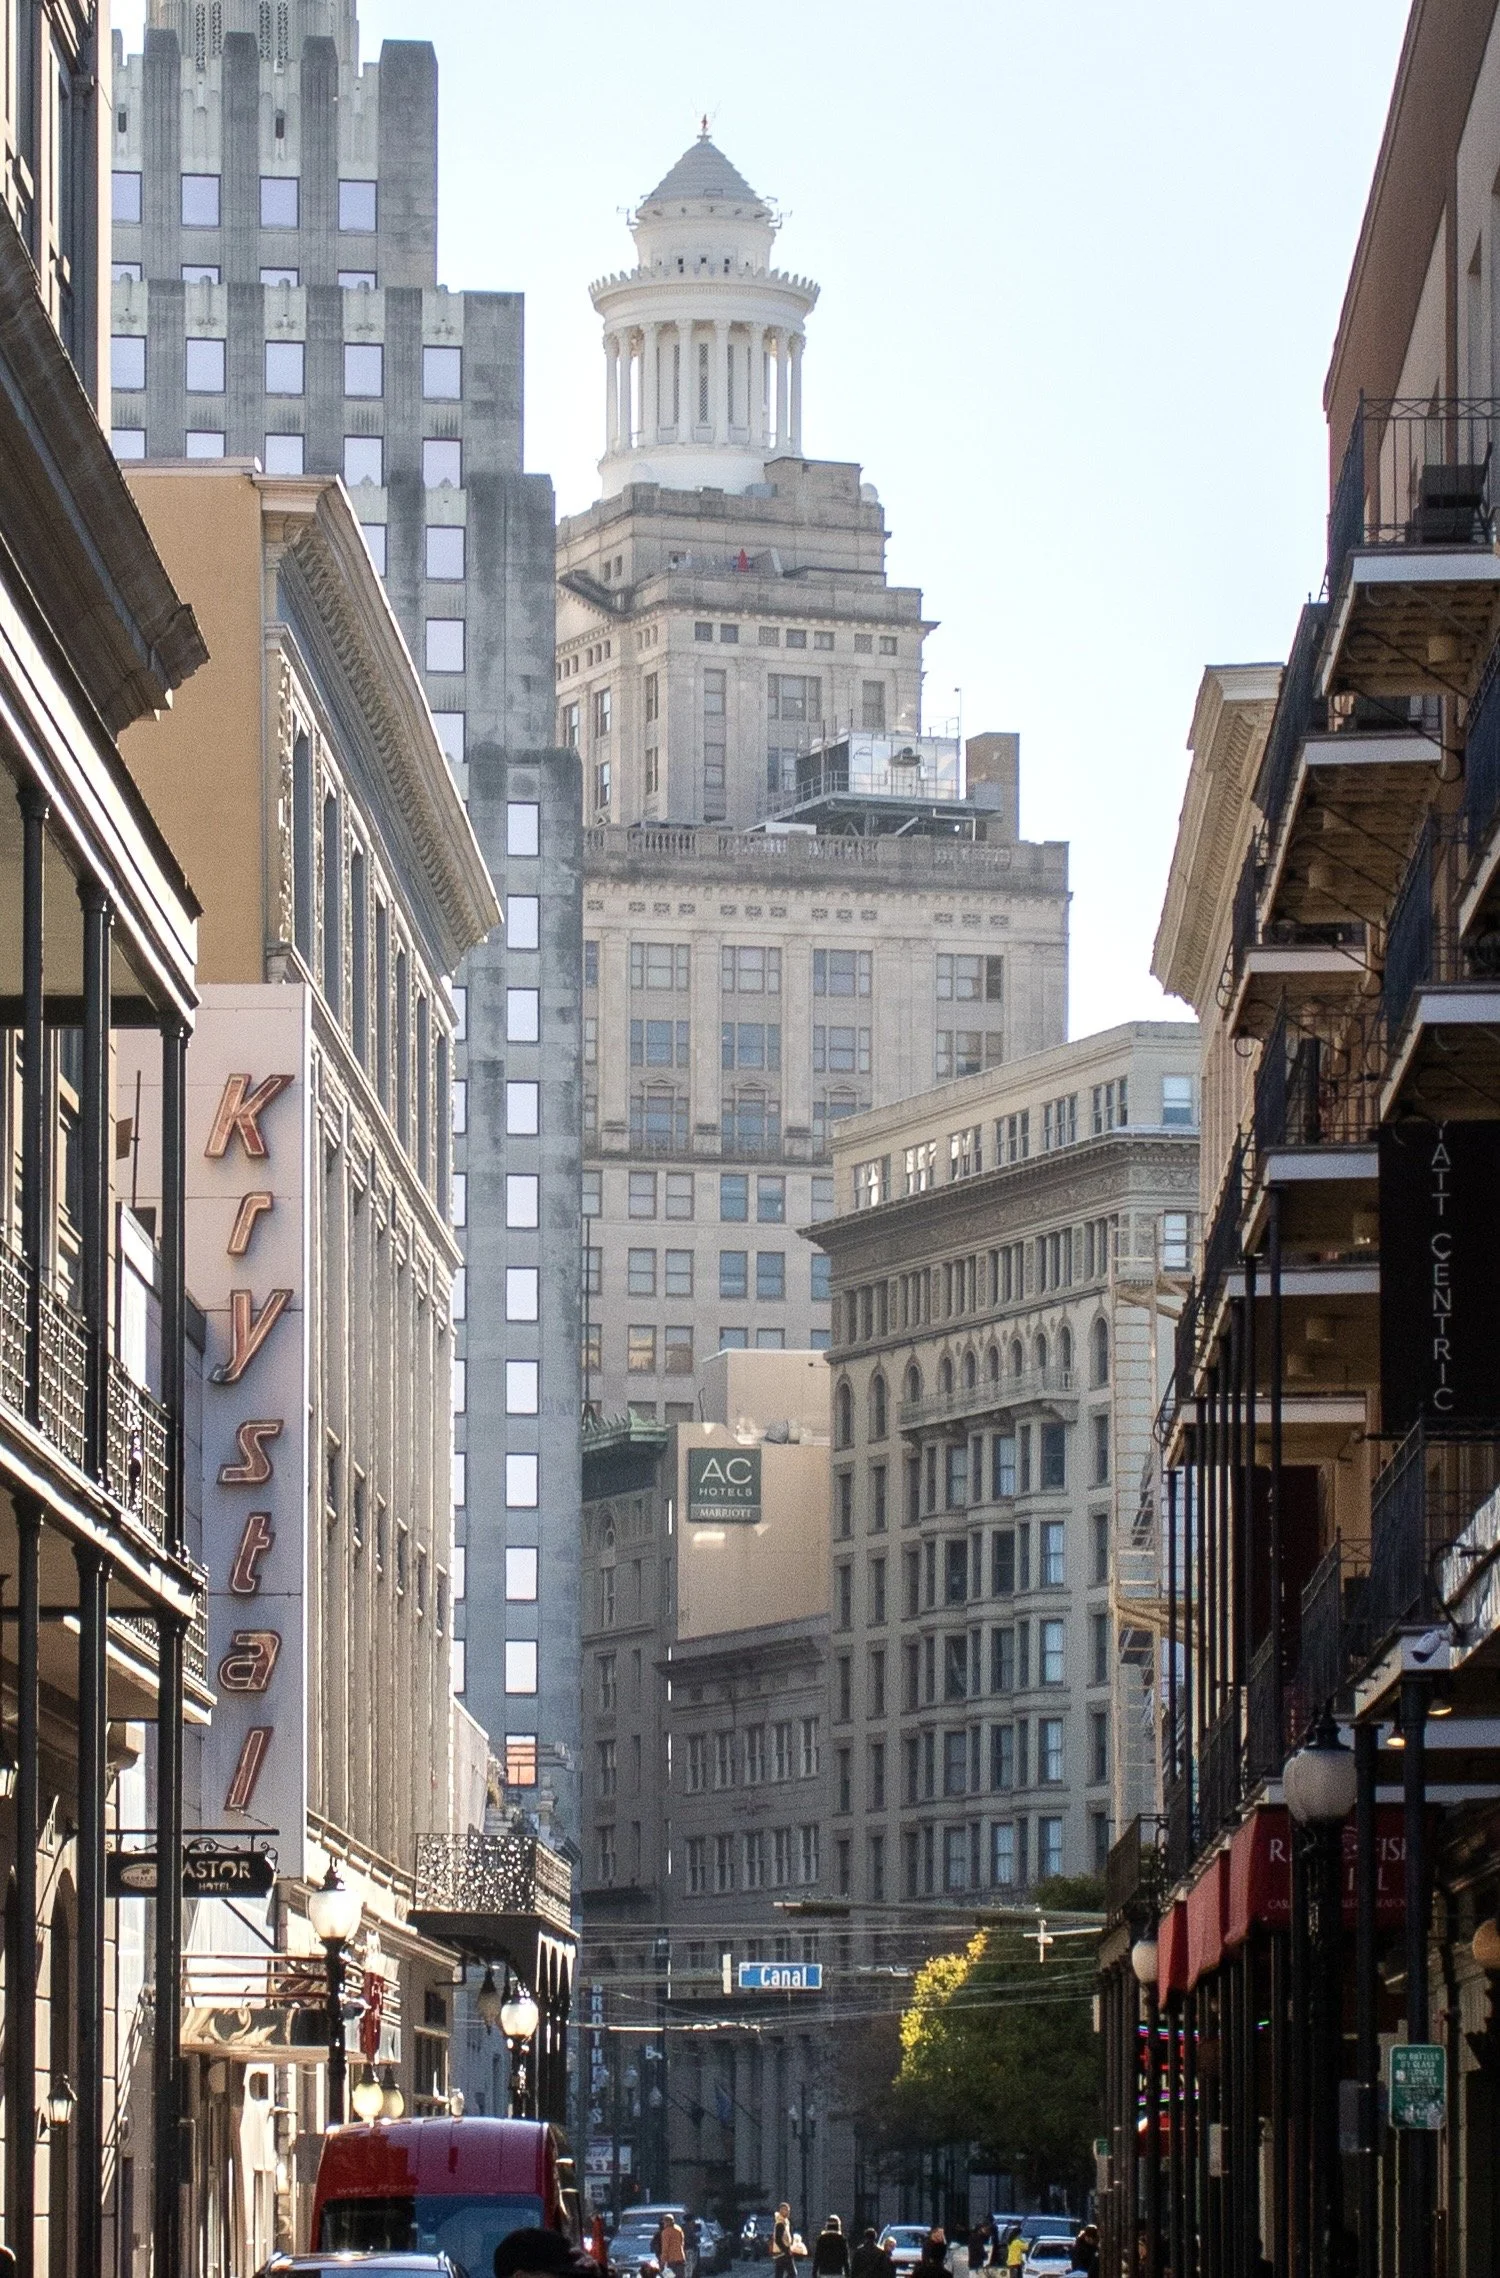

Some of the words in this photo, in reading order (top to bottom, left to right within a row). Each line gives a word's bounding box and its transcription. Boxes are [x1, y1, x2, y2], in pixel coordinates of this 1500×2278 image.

[1431, 1232, 1453, 1411] CENTRIC
[203, 1073, 295, 1811] Krystal
[700, 1457, 752, 1485] AC
[699, 1487, 753, 1497] HOTELS
[700, 1508, 751, 1518] MARRIOTT
[182, 1860, 251, 1879] ASTOR
[198, 1882, 231, 1892] HOTEL
[761, 1966, 807, 1988] Canal
